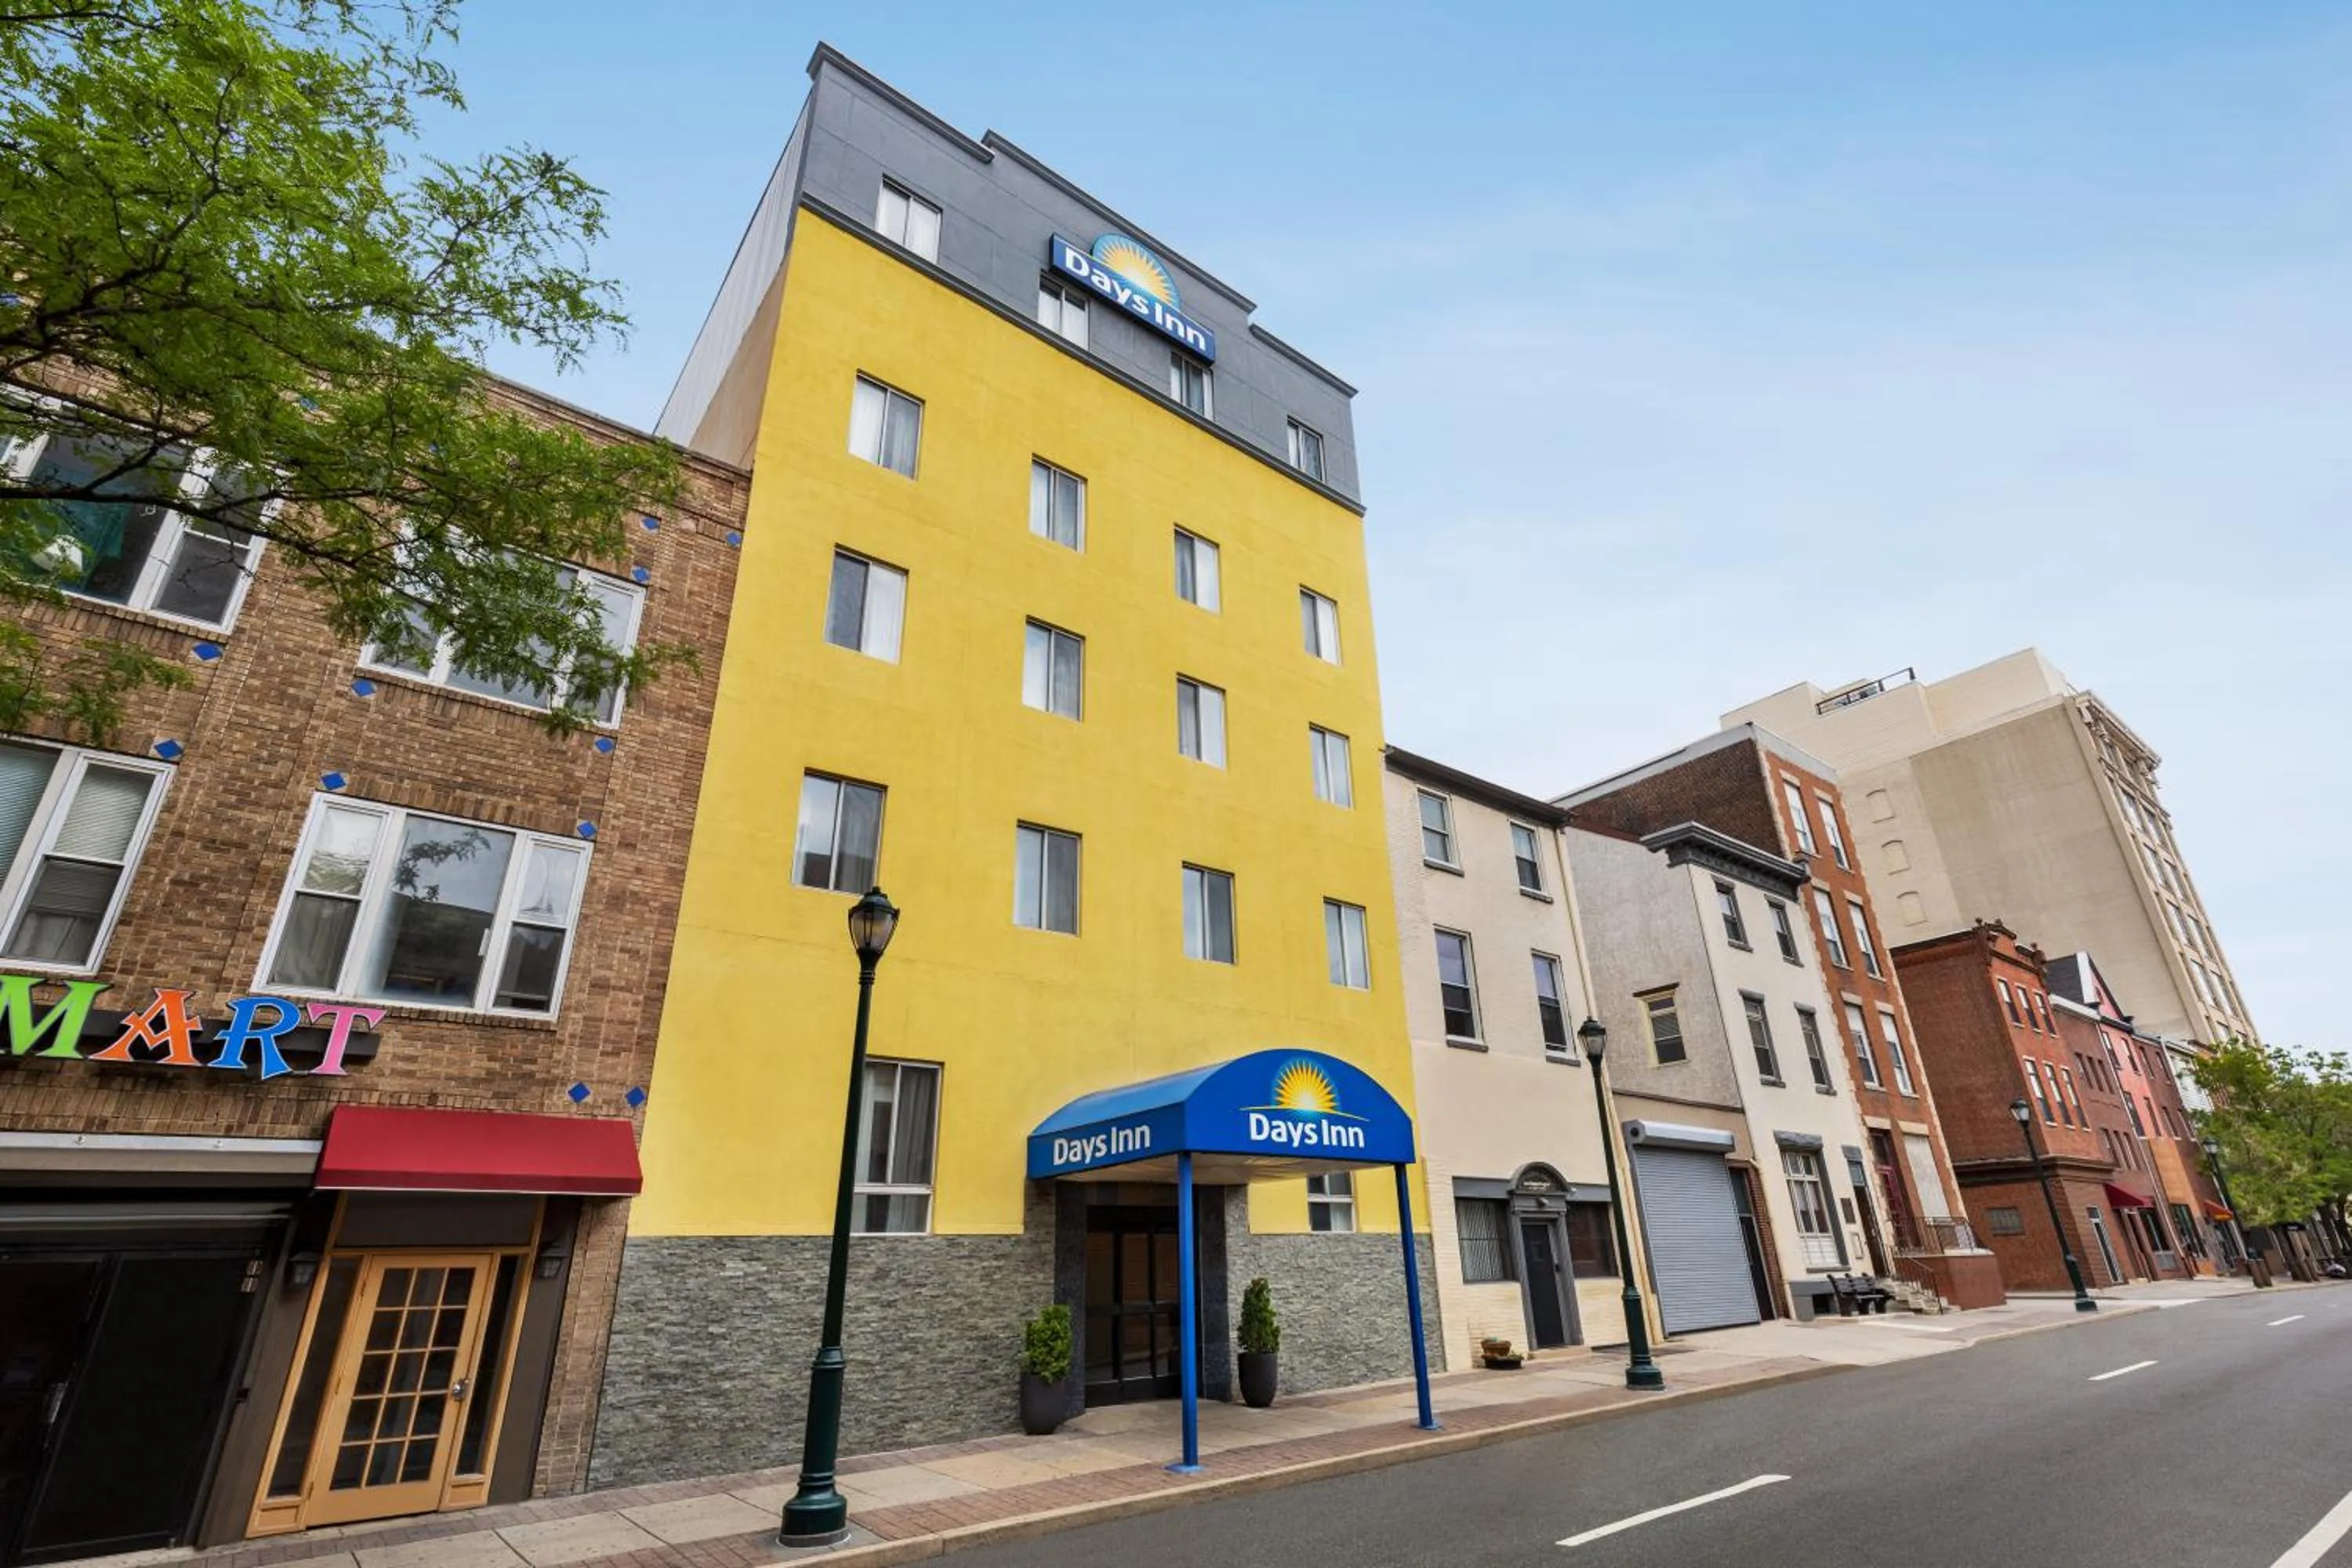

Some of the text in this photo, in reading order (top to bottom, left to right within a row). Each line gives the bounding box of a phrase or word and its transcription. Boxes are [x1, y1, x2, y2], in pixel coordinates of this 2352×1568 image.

[1065, 247, 1207, 352] Days Inn
[0, 975, 388, 1080] MART
[1053, 1125, 1151, 1166] Days Inn
[1249, 1112, 1365, 1149] Days Inn
